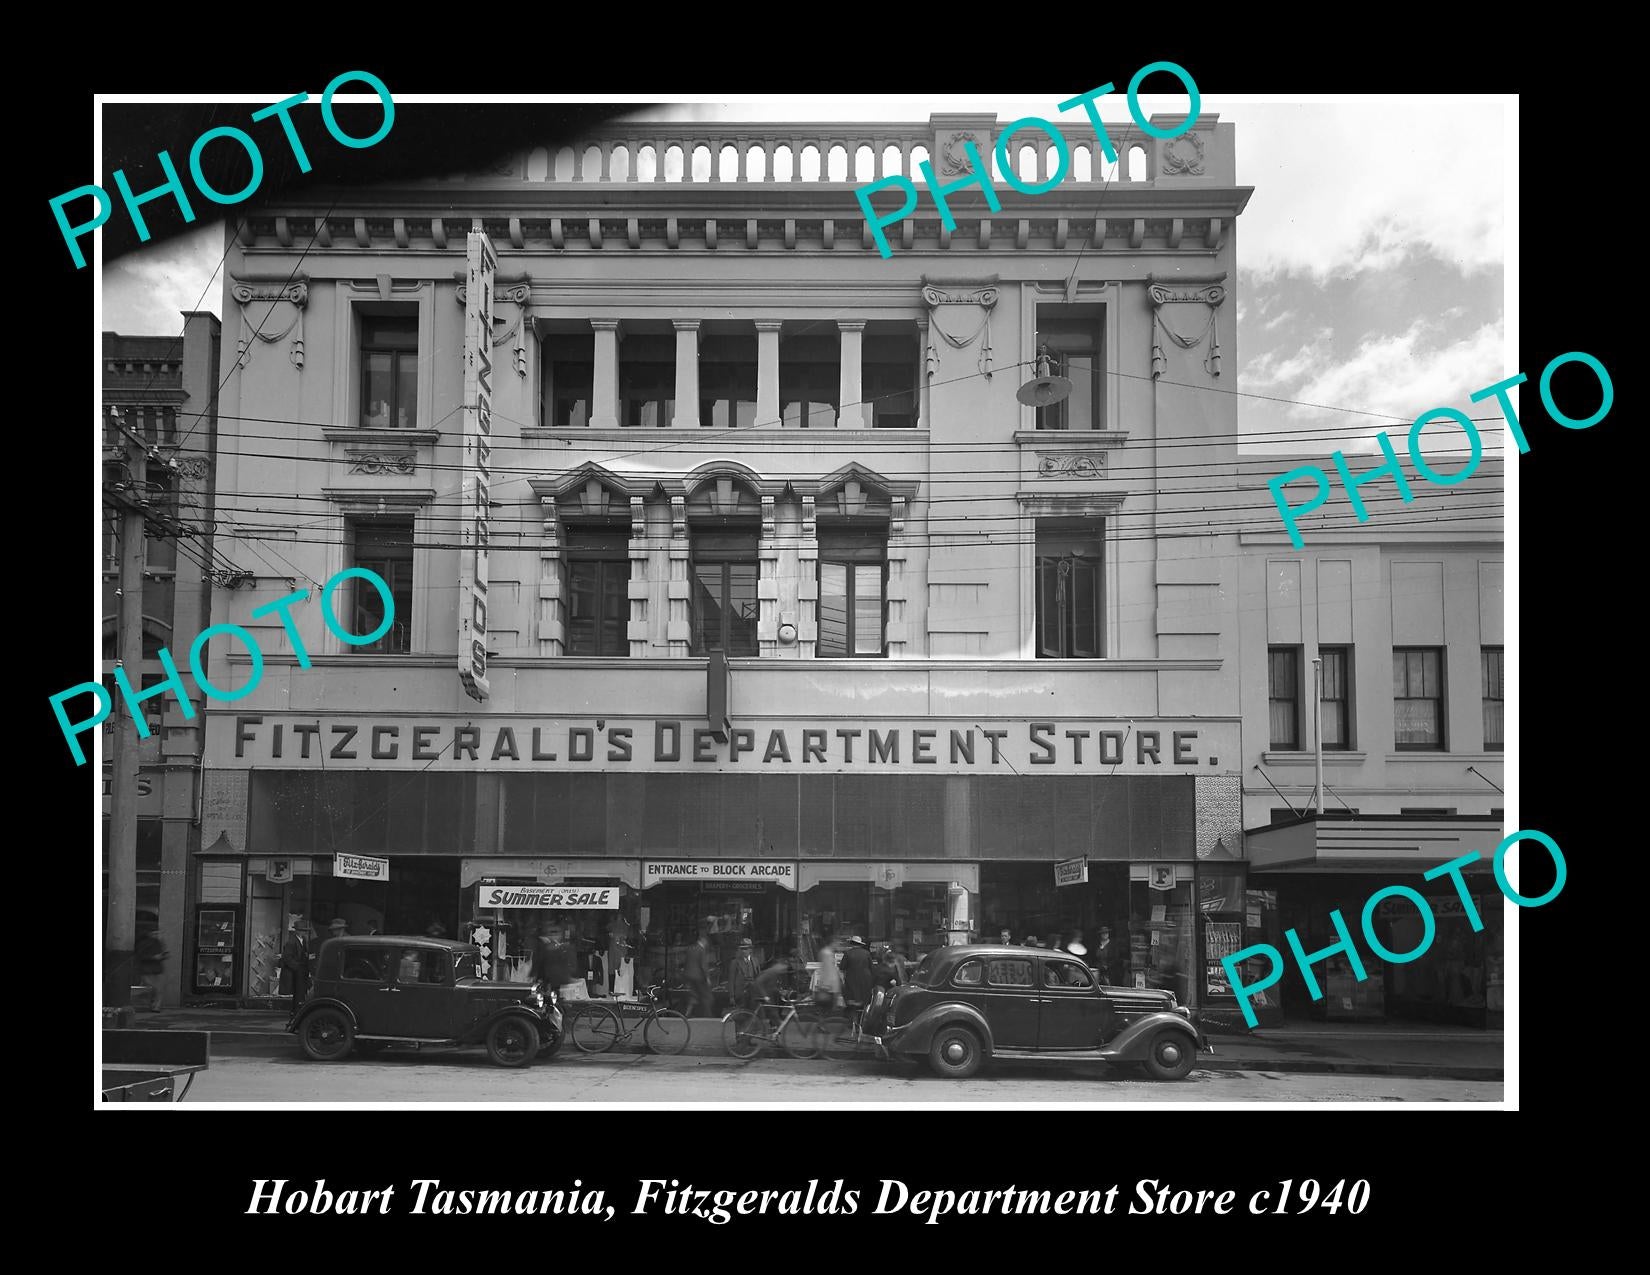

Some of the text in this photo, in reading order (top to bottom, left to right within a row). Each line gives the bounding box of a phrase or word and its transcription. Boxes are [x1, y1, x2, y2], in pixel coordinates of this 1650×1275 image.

[235, 716, 633, 762] FITZGERALD'S
[654, 720, 1008, 765] DEPARTMENT
[648, 864, 698, 875] ENTRANCE
[713, 865, 746, 875] BLOCK
[750, 866, 791, 876] ARCADE
[488, 889, 610, 906] SUMMER SALE
